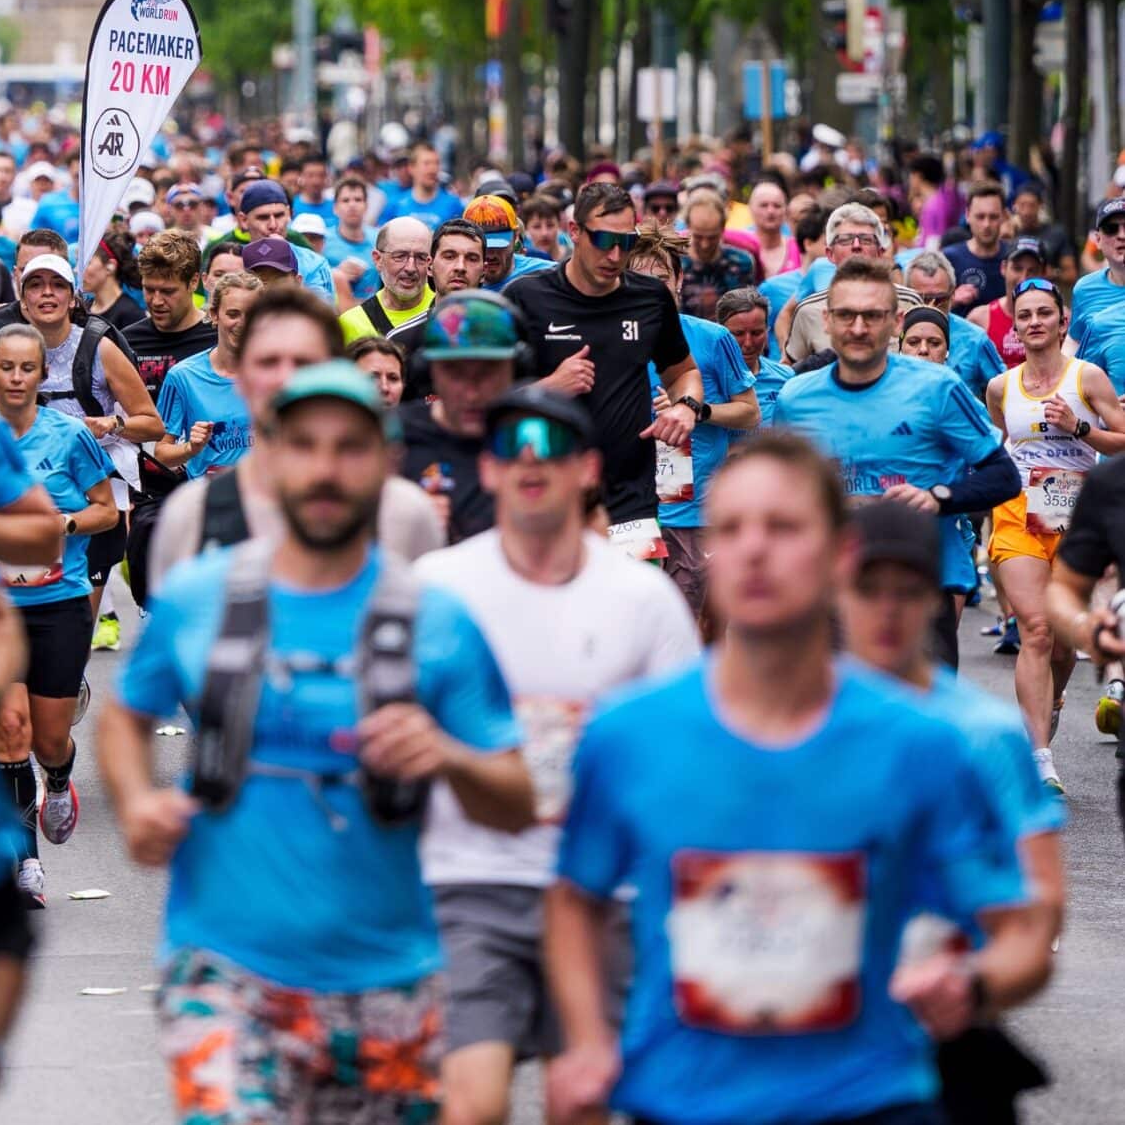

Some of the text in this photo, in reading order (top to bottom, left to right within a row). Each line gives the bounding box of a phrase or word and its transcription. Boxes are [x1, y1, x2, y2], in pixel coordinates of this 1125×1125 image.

[109, 29, 194, 61] PACEMAKER
[109, 61, 171, 96] 20 KM
[621, 319, 639, 341] 31
